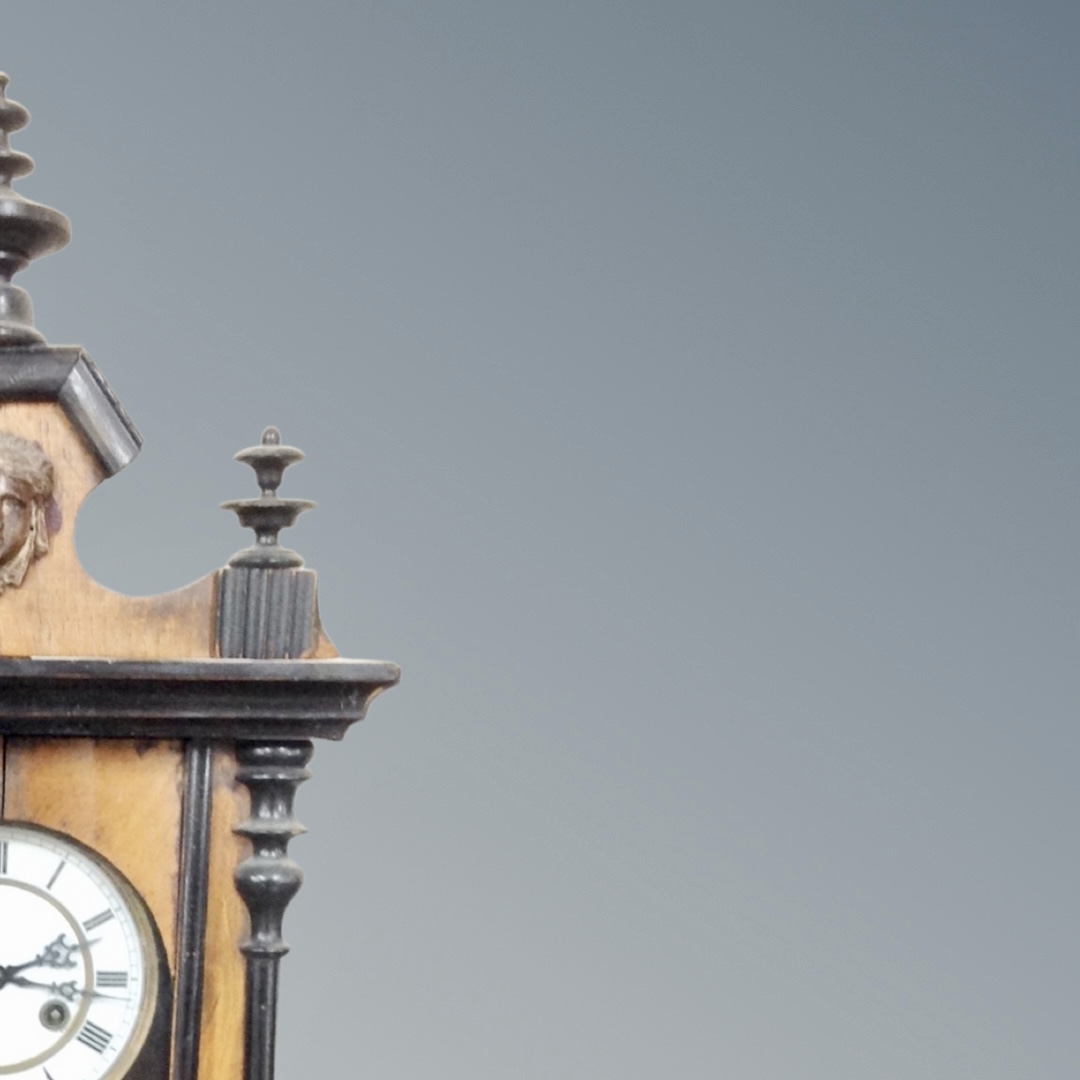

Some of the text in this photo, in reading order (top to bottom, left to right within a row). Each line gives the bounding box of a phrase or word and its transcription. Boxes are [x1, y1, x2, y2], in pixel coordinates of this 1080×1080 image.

[46, 860, 67, 890] I
[82, 908, 116, 932] II
[95, 970, 128, 988] III
